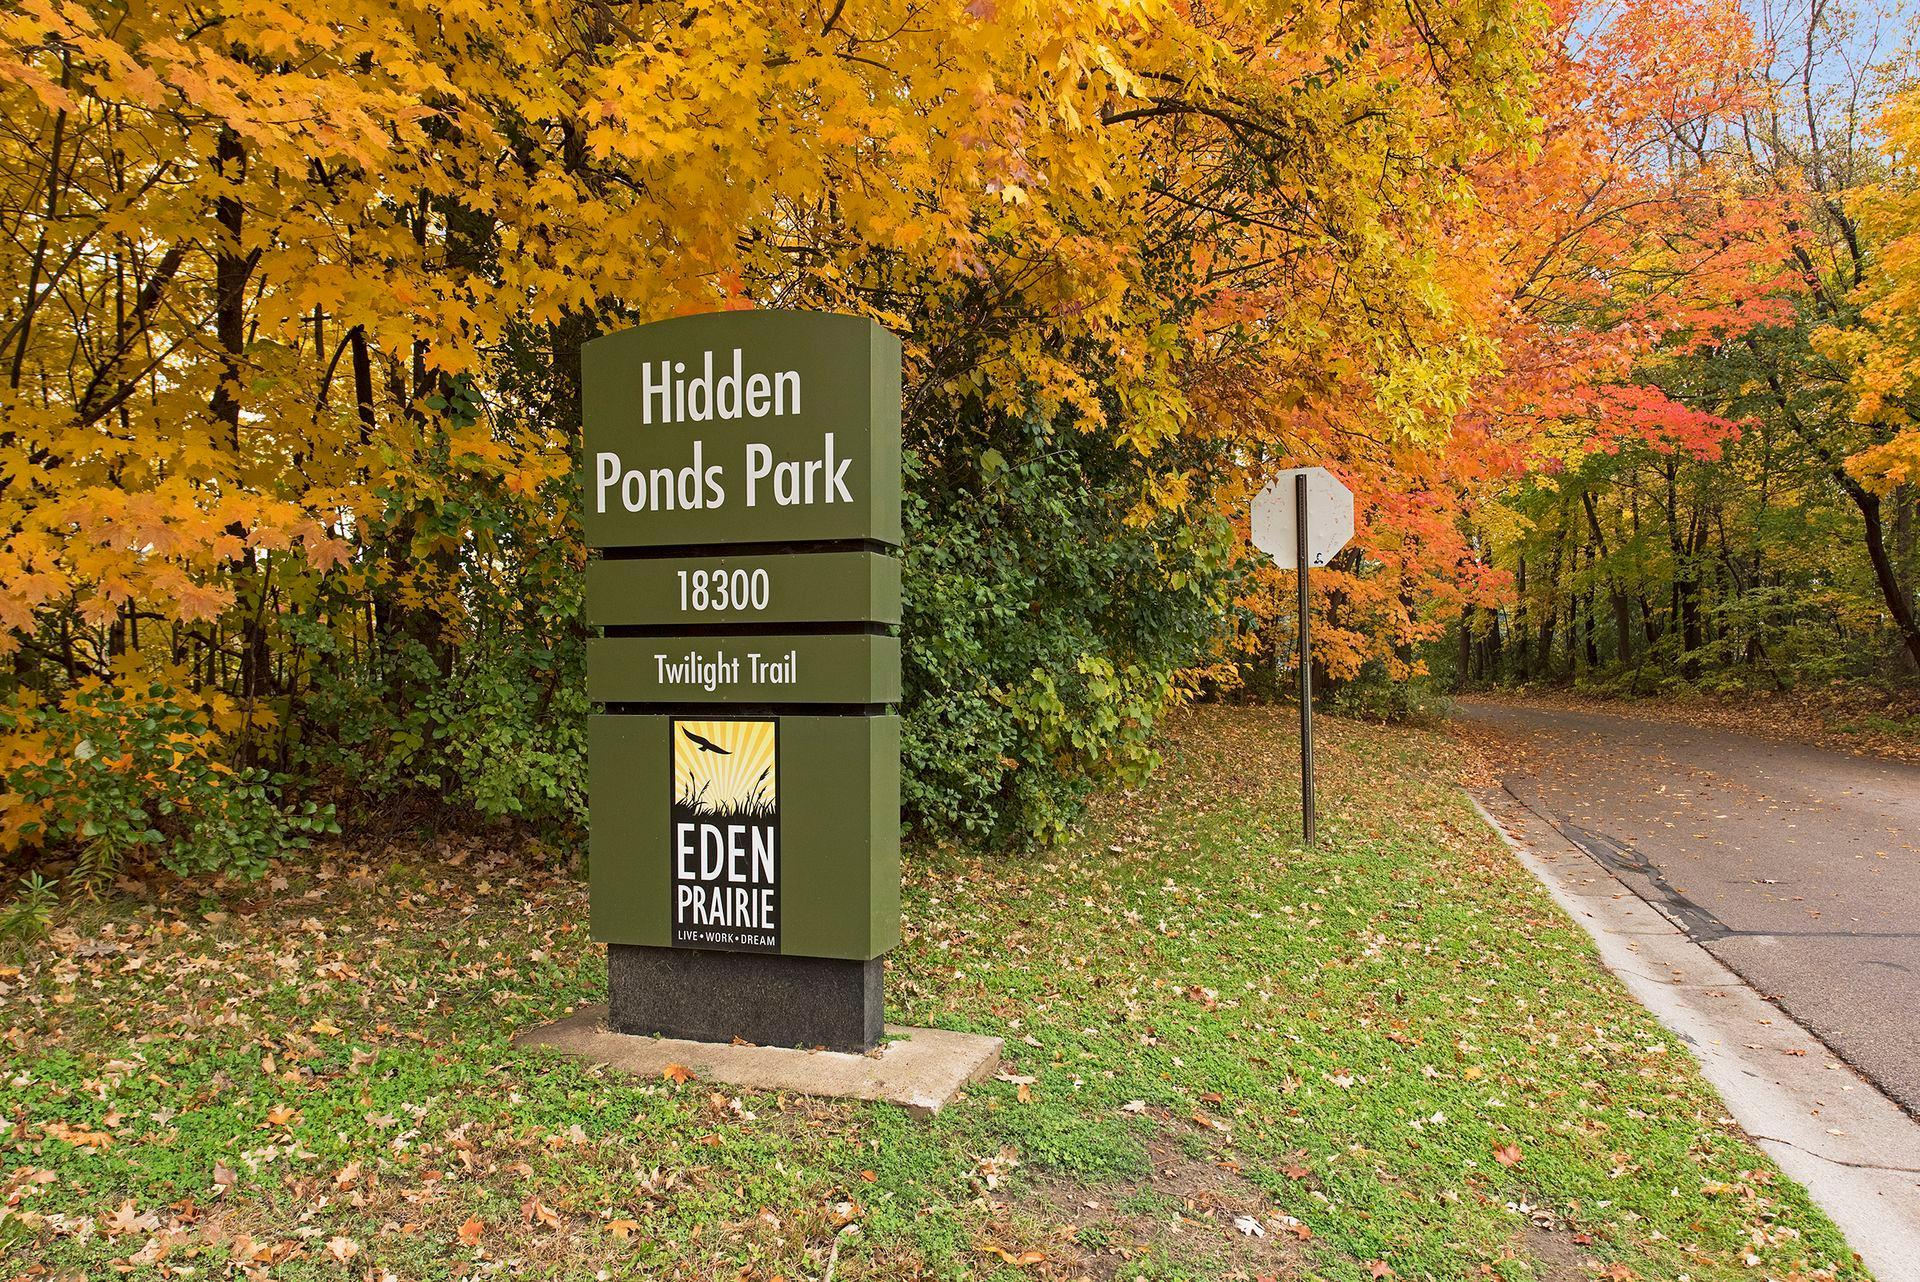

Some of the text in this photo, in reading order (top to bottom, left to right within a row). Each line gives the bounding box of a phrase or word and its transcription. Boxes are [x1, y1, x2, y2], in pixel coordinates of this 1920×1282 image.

[642, 348, 801, 425] Hidden
[596, 432, 854, 514] Ponds Park
[677, 568, 770, 611] 18300
[653, 650, 797, 692] Twilight Trail
[677, 822, 775, 884] EDEN
[677, 884, 775, 929] PRAIRIE
[678, 930, 776, 946] LIVE WORK DREAM
